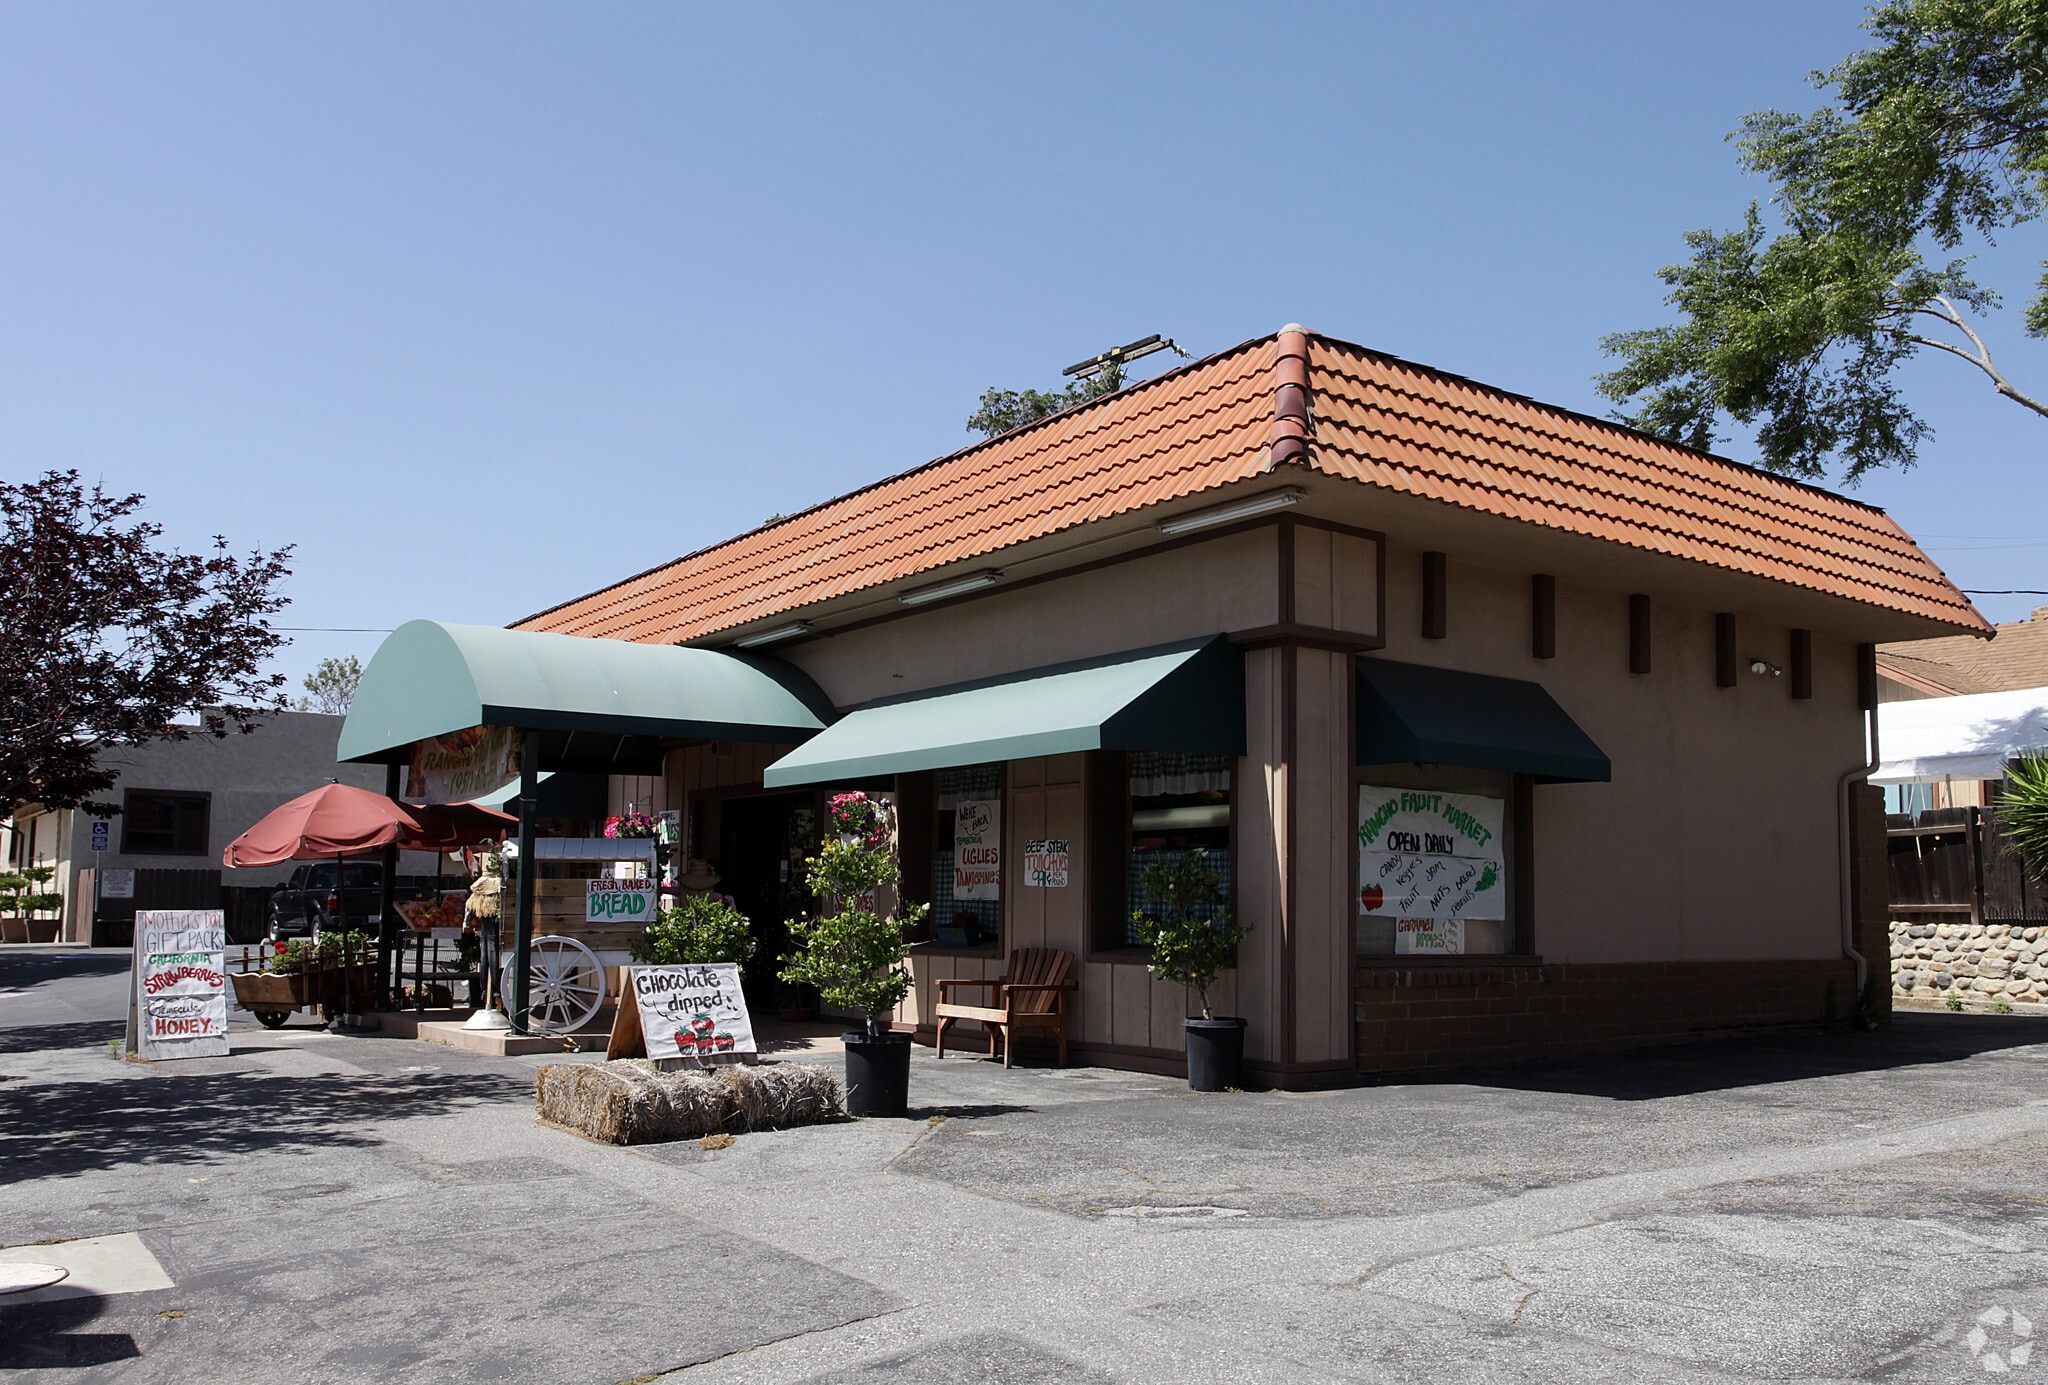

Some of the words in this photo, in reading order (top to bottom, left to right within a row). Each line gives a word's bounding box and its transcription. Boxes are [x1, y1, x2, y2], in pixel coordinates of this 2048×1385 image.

[1358, 799, 1398, 847] RANCHO
[1401, 792, 1443, 813] FRUIT
[1442, 803, 1492, 847] MARKET
[1025, 840, 1045, 854] BEEF
[1046, 840, 1069, 854] STEAK
[1388, 831, 1420, 851] OPEN
[1424, 833, 1454, 854] DAILY
[962, 847, 998, 865] UGLIES
[1379, 855, 1403, 878] CANDY
[622, 879, 651, 890] BAKED
[588, 893, 646, 919] BREAD
[1430, 885, 1451, 912] NUTS
[146, 931, 185, 954] GIFT
[188, 931, 225, 951] PACKS
[148, 953, 213, 965] CALIFORNIA
[144, 966, 224, 994] STRAWBERRIES
[155, 1018, 212, 1036] HONEY
